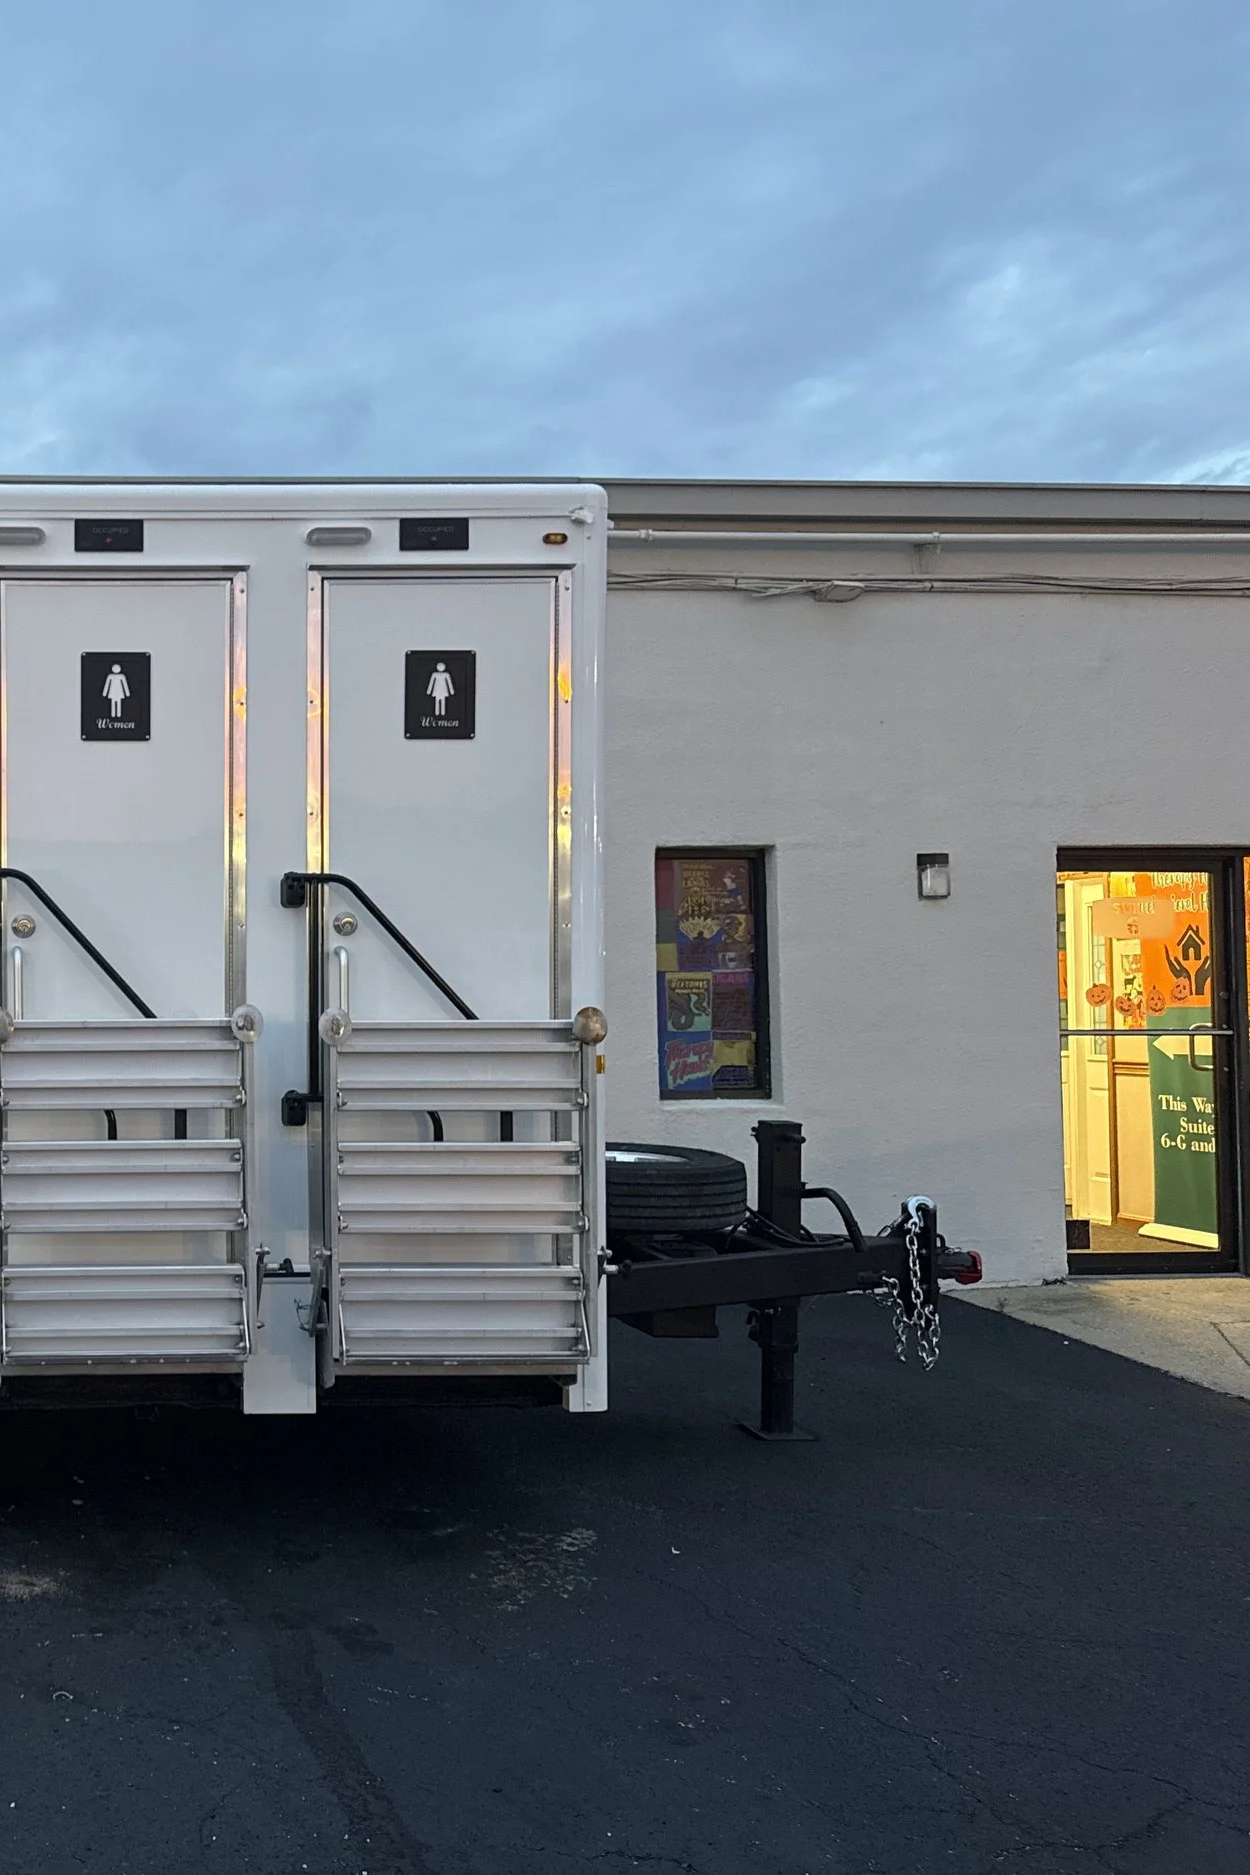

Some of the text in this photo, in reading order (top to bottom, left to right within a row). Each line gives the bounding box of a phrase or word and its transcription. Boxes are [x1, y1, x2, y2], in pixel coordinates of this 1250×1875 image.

[96, 717, 135, 729] Women
[421, 716, 460, 728] Women
[1158, 1094, 1187, 1112] This
[1180, 1116, 1215, 1135] Suite
[1160, 1133, 1216, 1153] 6-G and
